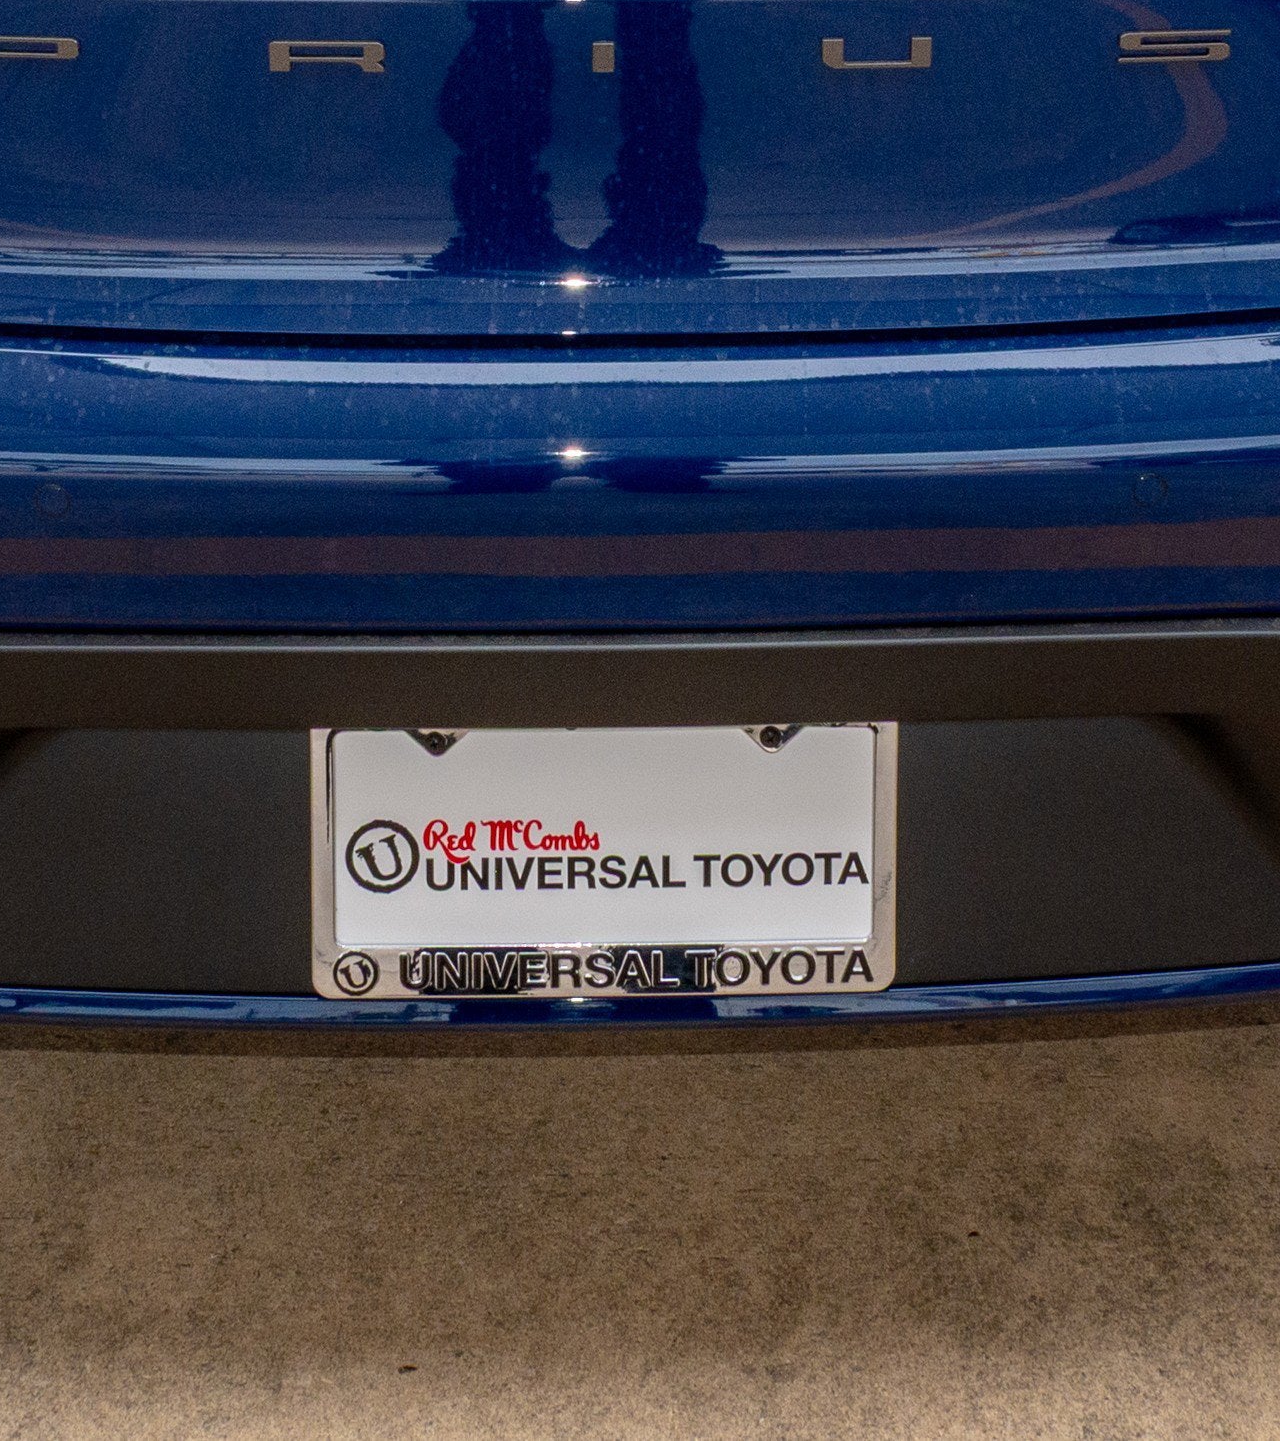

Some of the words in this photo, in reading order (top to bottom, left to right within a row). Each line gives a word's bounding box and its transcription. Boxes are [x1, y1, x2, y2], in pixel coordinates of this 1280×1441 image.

[422, 819, 477, 865] Red
[480, 819, 601, 852] McCombs
[425, 854, 686, 892] UNIVERSAL
[693, 851, 870, 888] TOYOTA
[398, 947, 681, 991] UNIVERSAL
[684, 946, 874, 988] TOYOTA
